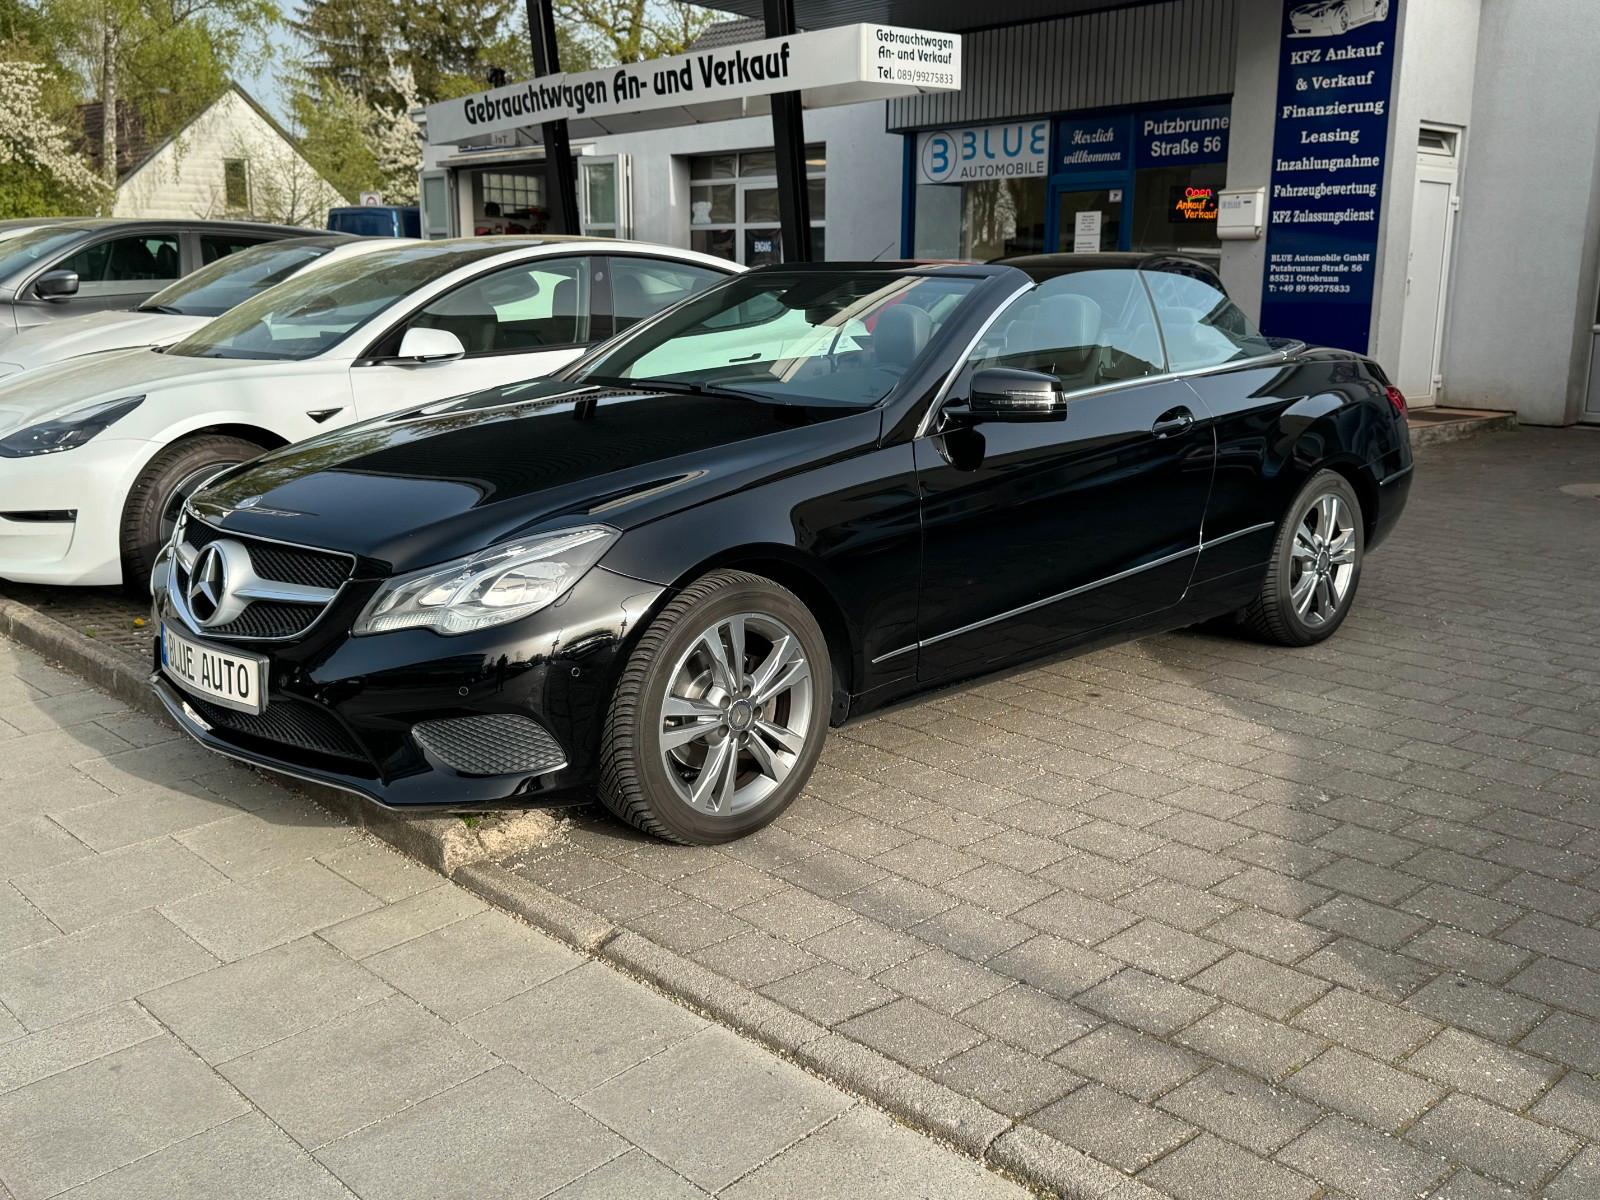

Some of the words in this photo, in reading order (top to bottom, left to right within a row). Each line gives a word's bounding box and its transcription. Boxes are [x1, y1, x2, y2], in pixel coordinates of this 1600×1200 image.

[876, 29, 953, 51] Gebrauchtwagen
[878, 45, 894, 59] An-
[897, 49, 915, 60] und
[917, 49, 952, 64] Verkauf
[1290, 49, 1321, 65] KFZ
[1325, 41, 1385, 62] Ankauf
[464, 79, 608, 125] Gebrauchtwagen
[613, 69, 647, 104] An-
[653, 59, 693, 96] und
[697, 42, 790, 89] Verkauf
[877, 66, 895, 80] Tel.
[897, 69, 953, 85] 089/99275833
[1296, 79, 1308, 91] &
[1312, 71, 1375, 90] Verkauf
[1282, 100, 1385, 119] Finanzierung
[1144, 116, 1230, 137] Putzbrunne
[962, 123, 1046, 161] BLUE
[1072, 128, 1114, 145] Herzlich
[1301, 129, 1360, 145] Leasing
[1151, 138, 1199, 158] Straße
[1203, 136, 1222, 153] 56
[1063, 150, 1121, 165] willkommen
[1276, 154, 1380, 173] Inzahlungnahme
[961, 161, 1045, 179] AUTOMOBILE
[1185, 187, 1212, 198] Open
[1273, 182, 1377, 200] Fahrzeugbewertung
[1175, 198, 1207, 211] Ankauf
[1184, 208, 1218, 219] Verkauf
[1272, 210, 1291, 224] KFZ
[1293, 208, 1375, 226] Zulassungsdienst
[1271, 254, 1293, 262] BLUE
[1294, 254, 1342, 262] Automobile
[1343, 253, 1370, 262] GmbH
[1321, 263, 1349, 272] Straße
[1350, 264, 1363, 272] 56
[1296, 274, 1339, 282] Ottobrunn
[1268, 284, 1277, 292] T:
[1279, 284, 1294, 293] +49
[1295, 284, 1307, 293] 89
[1308, 284, 1351, 293] 99275833
[168, 632, 195, 682] BLUE
[202, 652, 249, 699] AUTO
